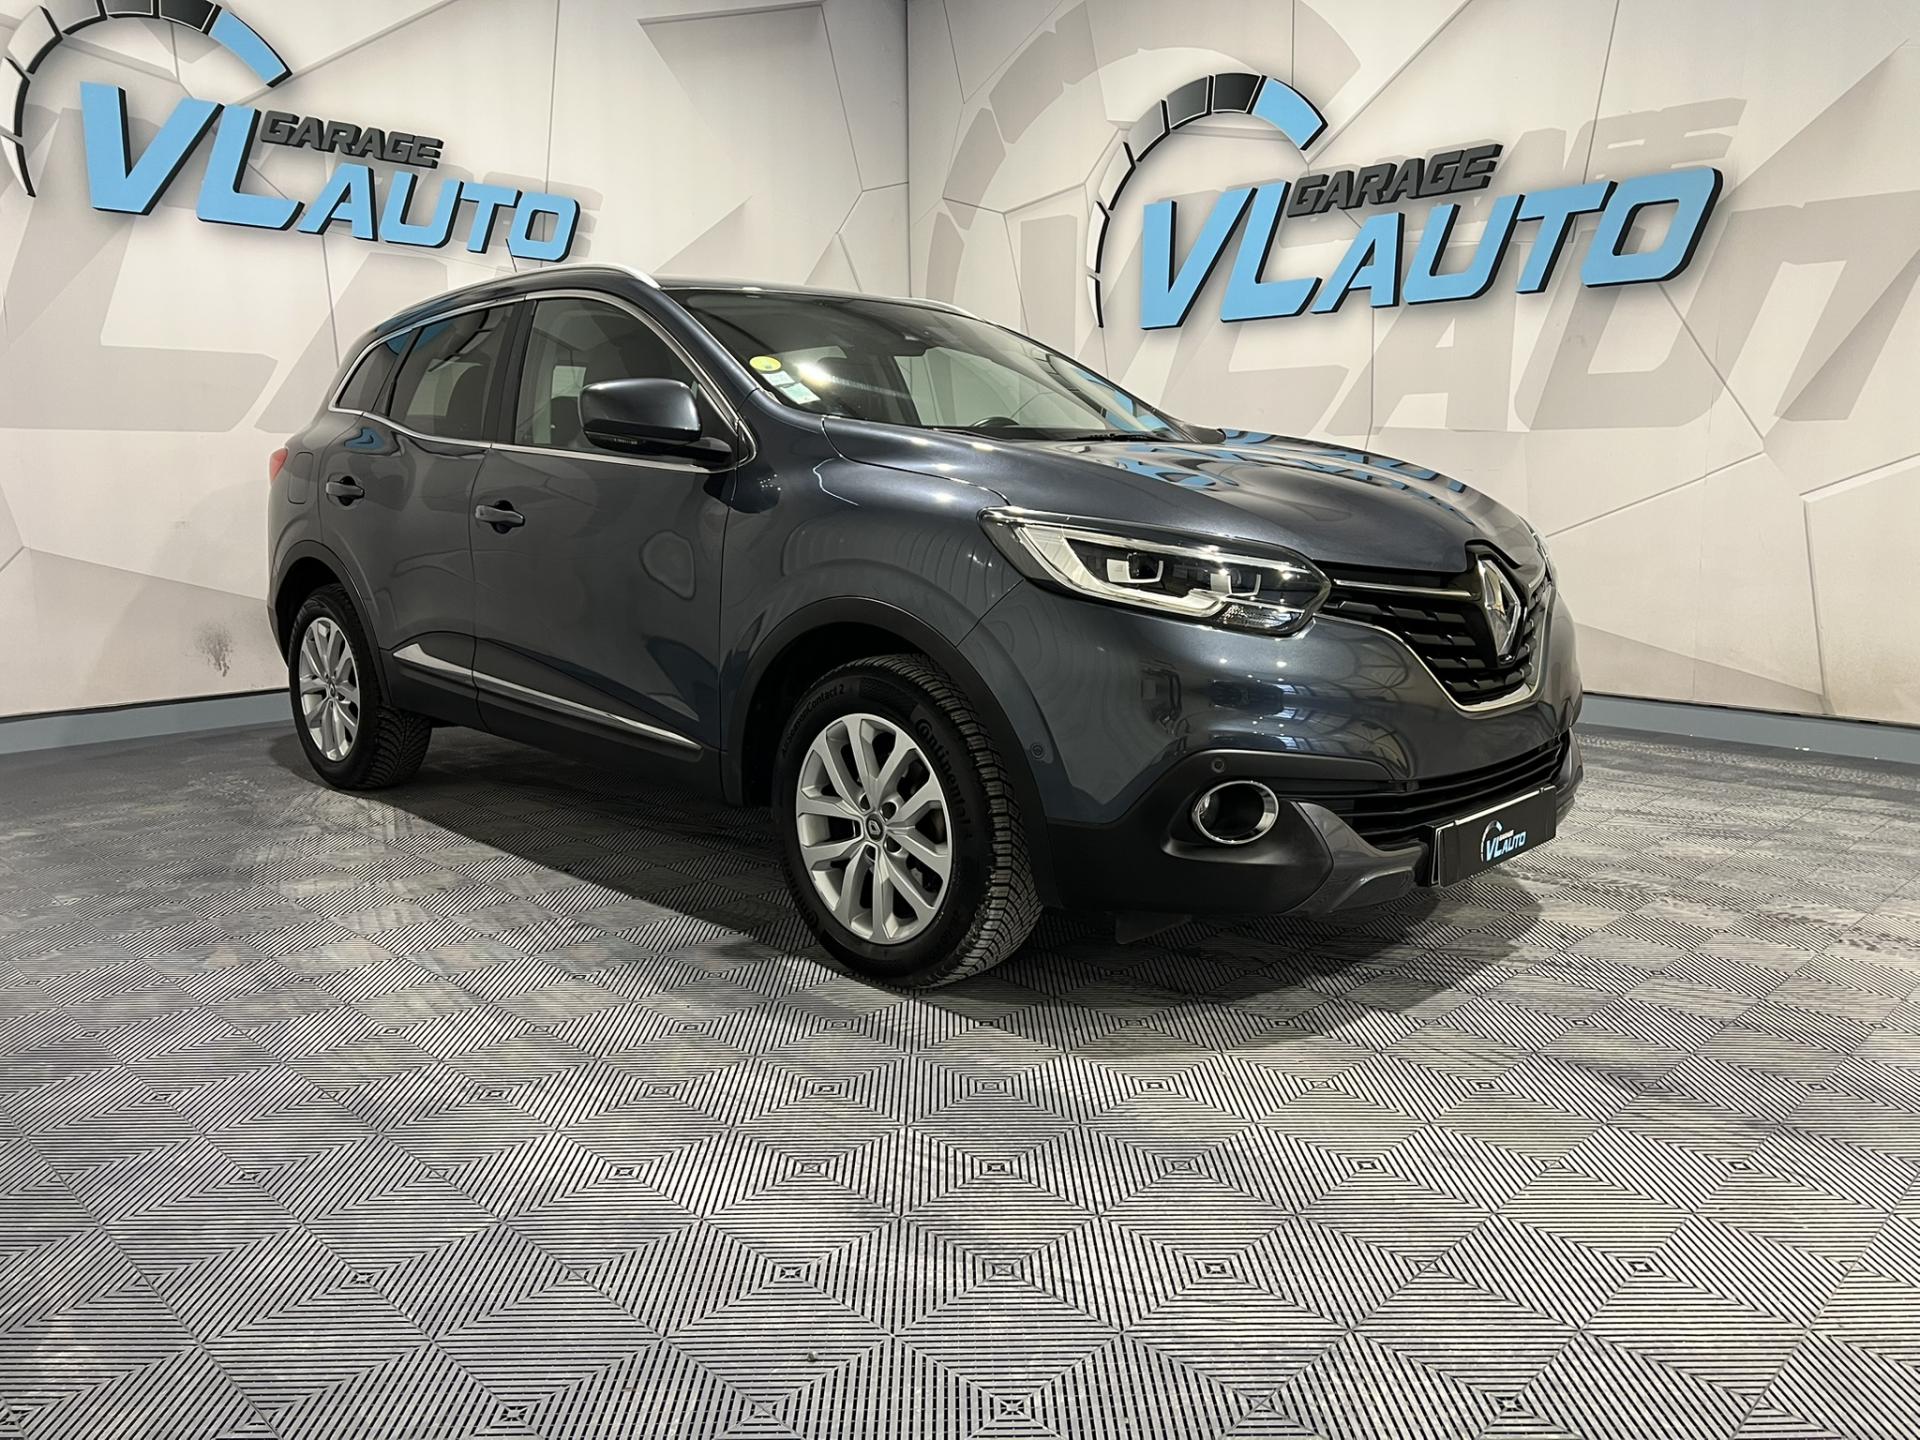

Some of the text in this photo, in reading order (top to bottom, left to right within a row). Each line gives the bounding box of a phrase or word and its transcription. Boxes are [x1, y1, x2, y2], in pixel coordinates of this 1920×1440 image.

[259, 110, 444, 169] GARAGE
[1287, 143, 1503, 218] GARAGE
[838, 682, 845, 696] 2
[914, 717, 971, 824] Continental
